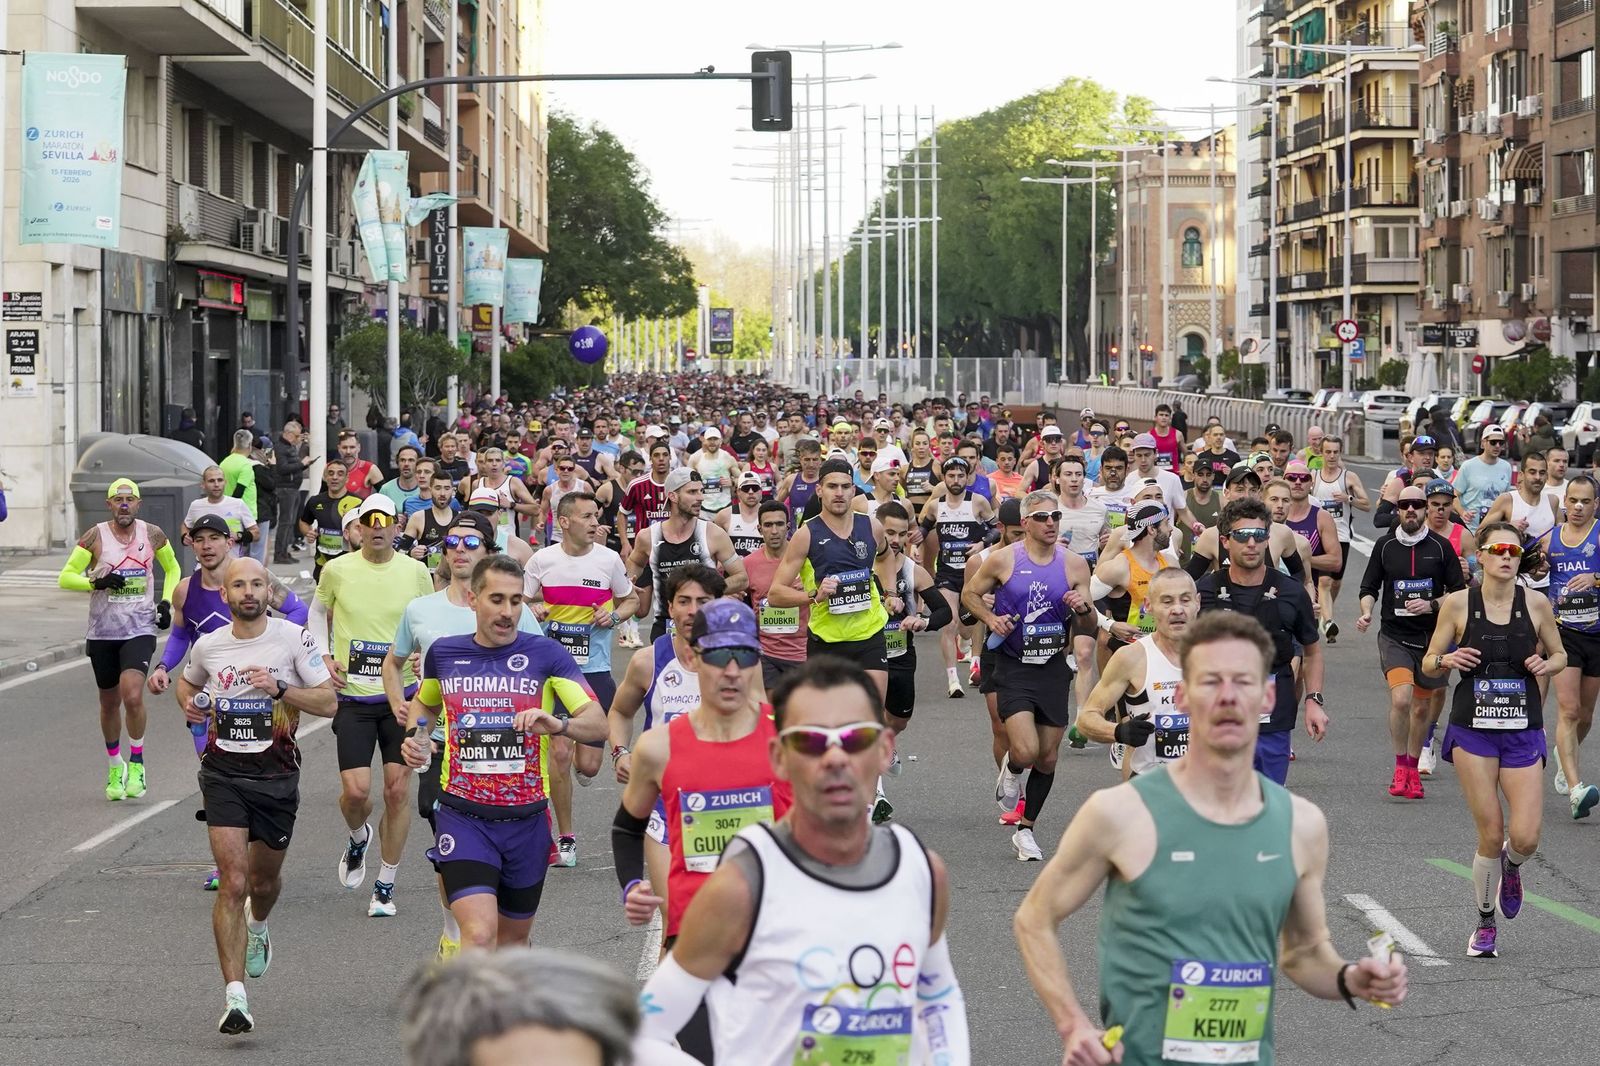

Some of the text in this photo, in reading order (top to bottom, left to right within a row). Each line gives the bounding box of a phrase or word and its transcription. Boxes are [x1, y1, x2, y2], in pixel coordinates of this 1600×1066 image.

[43, 130, 84, 139] ZURICH
[42, 142, 85, 151] MARATON
[42, 151, 84, 160] SEVILLA
[60, 169, 92, 177] FEBRERO
[433, 204, 448, 277] ENTOFT
[1449, 329, 1474, 338] TINTE
[14, 355, 31, 363] ZONA
[11, 365, 35, 373] PRIVADA
[1557, 560, 1590, 572] FIAAL
[841, 571, 865, 581] ZURICH
[828, 592, 871, 606] LUIS CARLOS
[763, 617, 796, 625] BOUBKRI
[884, 622, 901, 630] URIC
[1038, 625, 1063, 633] ZURICH
[366, 643, 390, 652] ZURIC
[887, 640, 903, 649] NDE
[564, 646, 588, 655] DERO
[441, 675, 539, 696] INFORMALES
[1492, 682, 1521, 690] ZURICH
[232, 702, 267, 710] ZURICH
[462, 697, 515, 708] ALCONCHEL
[1475, 705, 1527, 717] CHRYSTAL
[233, 717, 252, 726] 3625
[479, 715, 516, 725] ZURICH
[229, 728, 258, 740] PAUL
[480, 734, 502, 743] 3867
[460, 745, 526, 760] ADRI Y VAL
[711, 792, 761, 807] ZURICH
[715, 818, 742, 830] 3047
[1210, 967, 1263, 983] ZURICH
[1208, 998, 1240, 1012] 2777
[846, 1012, 904, 1032] ZURICH
[1193, 1018, 1247, 1038] KEVIN
